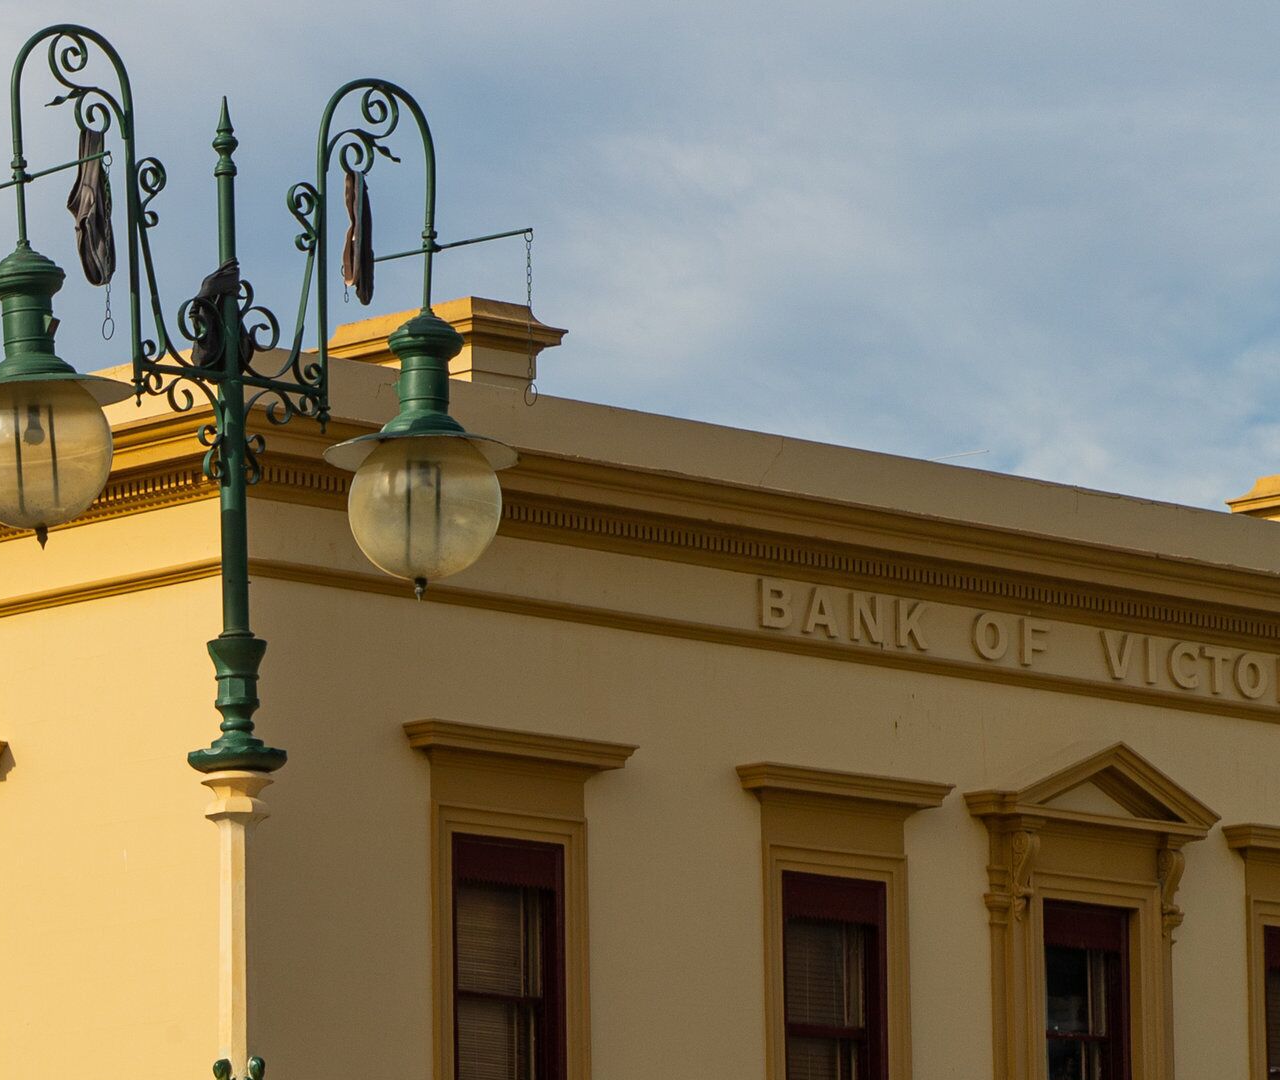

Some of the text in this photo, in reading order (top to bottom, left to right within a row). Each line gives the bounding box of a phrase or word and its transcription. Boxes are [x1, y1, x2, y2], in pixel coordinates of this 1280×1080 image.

[757, 578, 1280, 700] BANK OF VICTO
